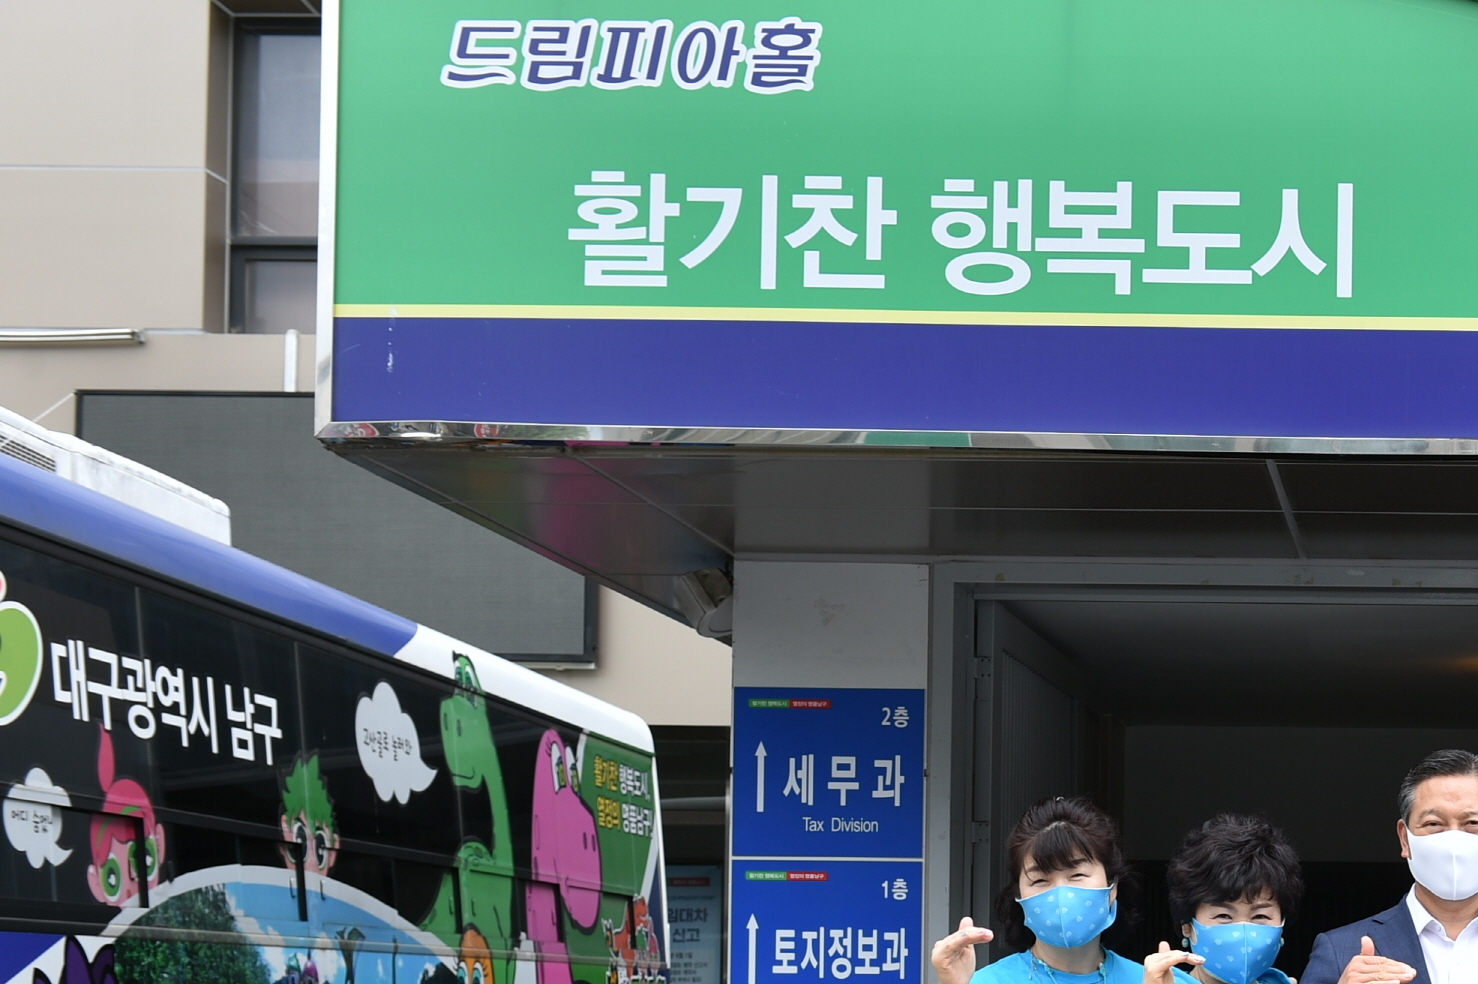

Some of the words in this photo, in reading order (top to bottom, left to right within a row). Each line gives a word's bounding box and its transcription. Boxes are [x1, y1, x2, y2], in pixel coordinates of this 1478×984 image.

[442, 19, 821, 93] 드림피아홀
[568, 170, 897, 290] 활기찬
[931, 179, 1354, 298] 행복도시
[51, 639, 219, 754] 대구광역시
[226, 683, 283, 765] 남구
[881, 706, 910, 728] 2층
[783, 754, 905, 806] 세무과
[802, 817, 824, 832] Tax
[831, 817, 879, 833] Division
[881, 878, 909, 901] 1층
[772, 926, 908, 980] 토지정보과
